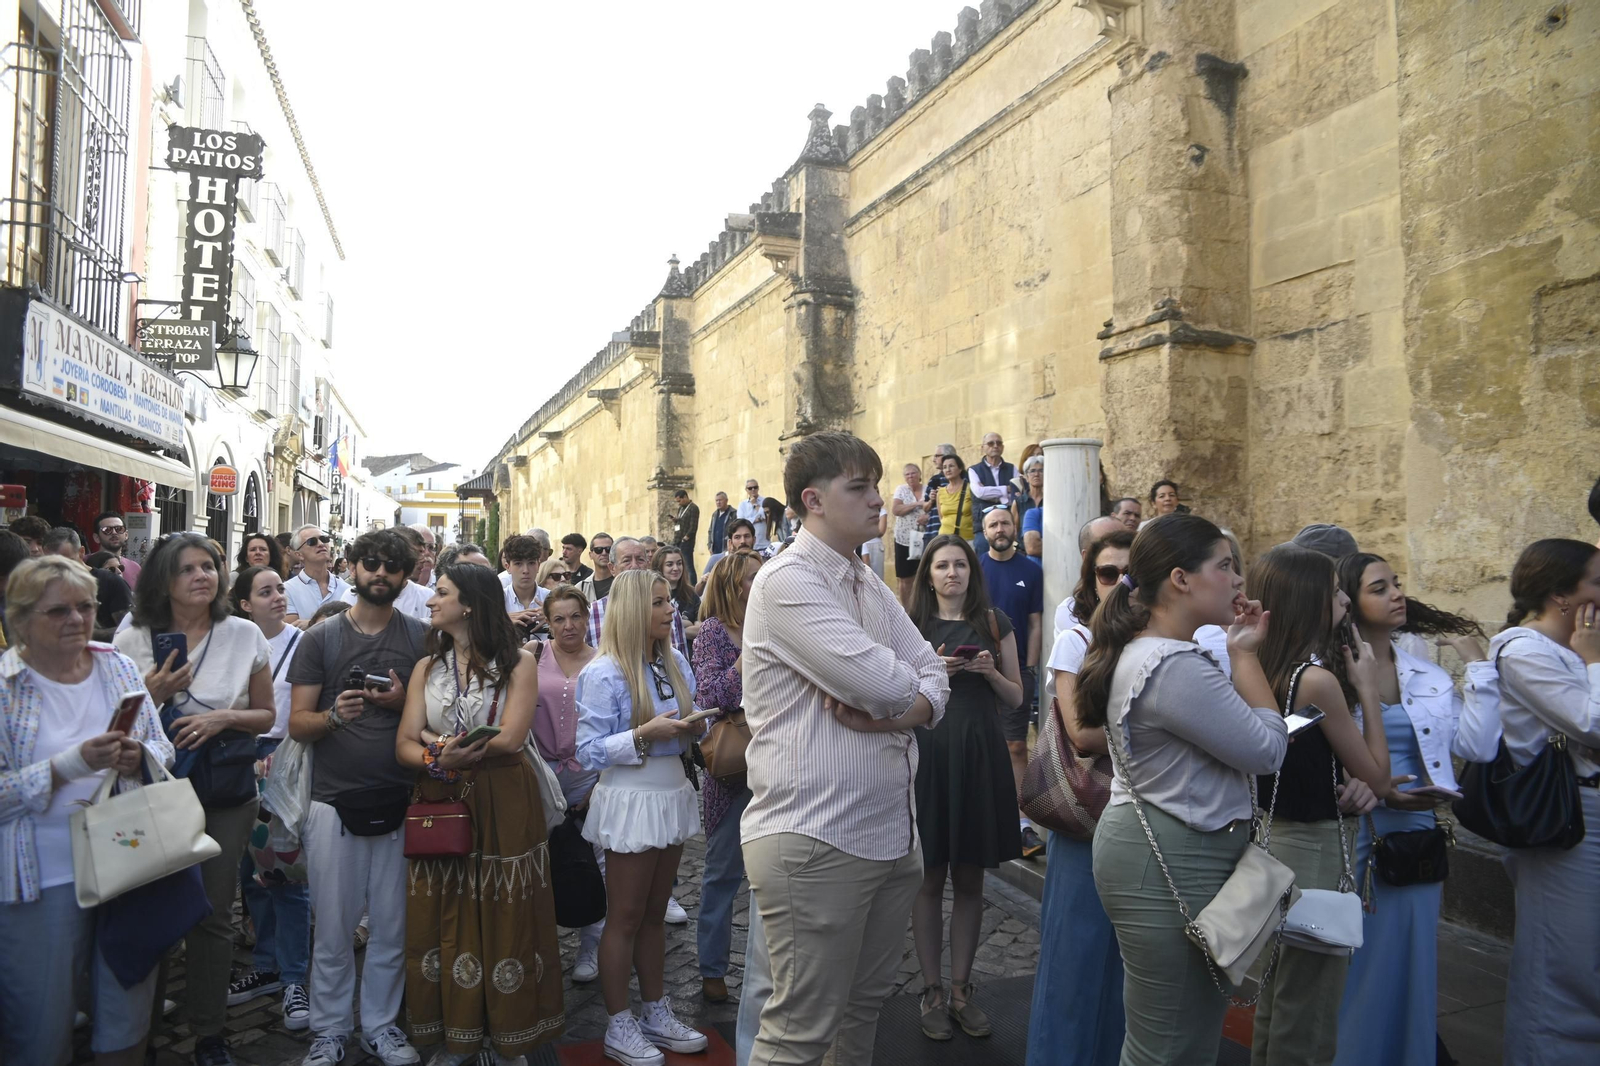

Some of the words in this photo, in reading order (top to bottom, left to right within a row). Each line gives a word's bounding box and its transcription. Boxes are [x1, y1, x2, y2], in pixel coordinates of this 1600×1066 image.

[193, 132, 237, 151] LOS
[171, 147, 255, 171] PATIOS
[144, 324, 210, 337] STROBAR
[55, 318, 121, 382] MANUEL
[125, 361, 136, 389] J.
[141, 368, 184, 413] REGALOS
[60, 358, 90, 385] JOYERIA
[91, 372, 128, 401] CORDOBESA
[133, 393, 161, 417] MANTONES
[161, 406, 168, 419] DE
[99, 398, 132, 424] MANTILLAS
[137, 414, 162, 435] ABANICOS
[210, 480, 236, 489] KING
